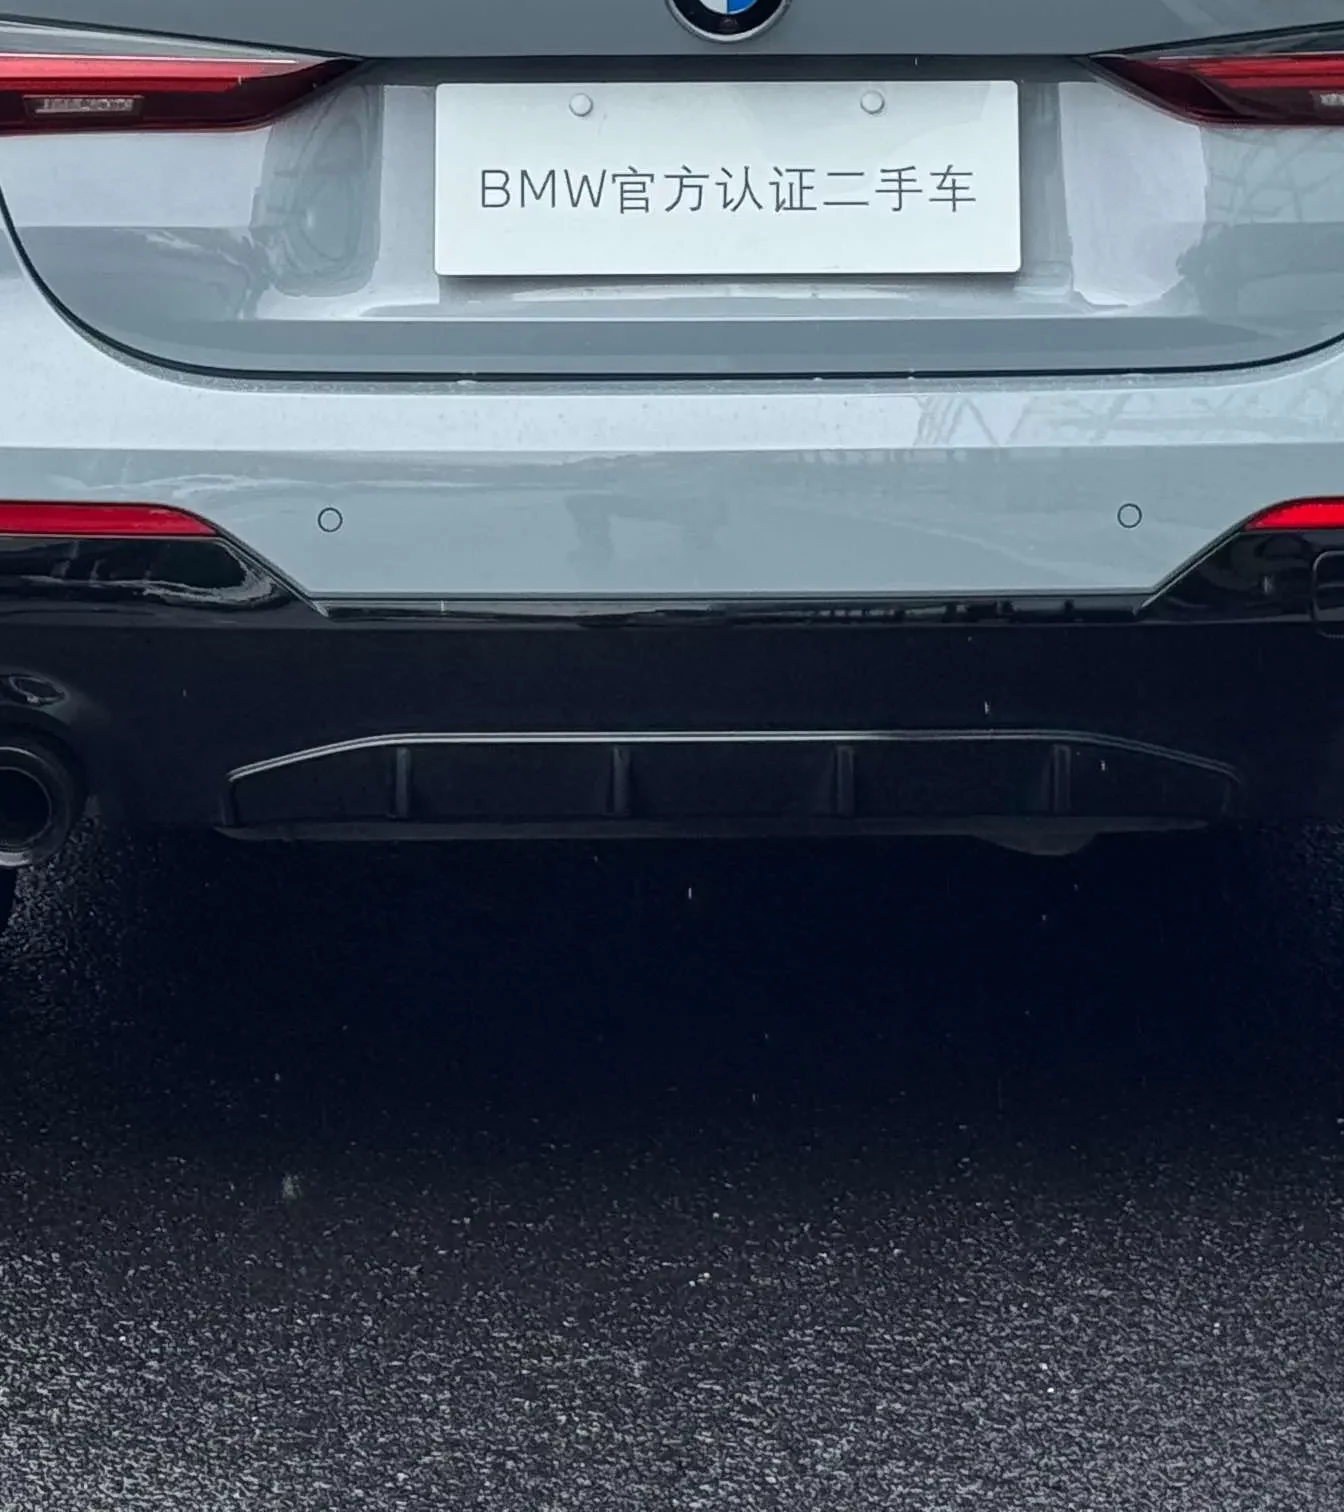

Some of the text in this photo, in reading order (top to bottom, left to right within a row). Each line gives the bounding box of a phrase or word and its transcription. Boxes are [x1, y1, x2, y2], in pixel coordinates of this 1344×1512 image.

[479, 165, 977, 215] BMW官方认证二手车
